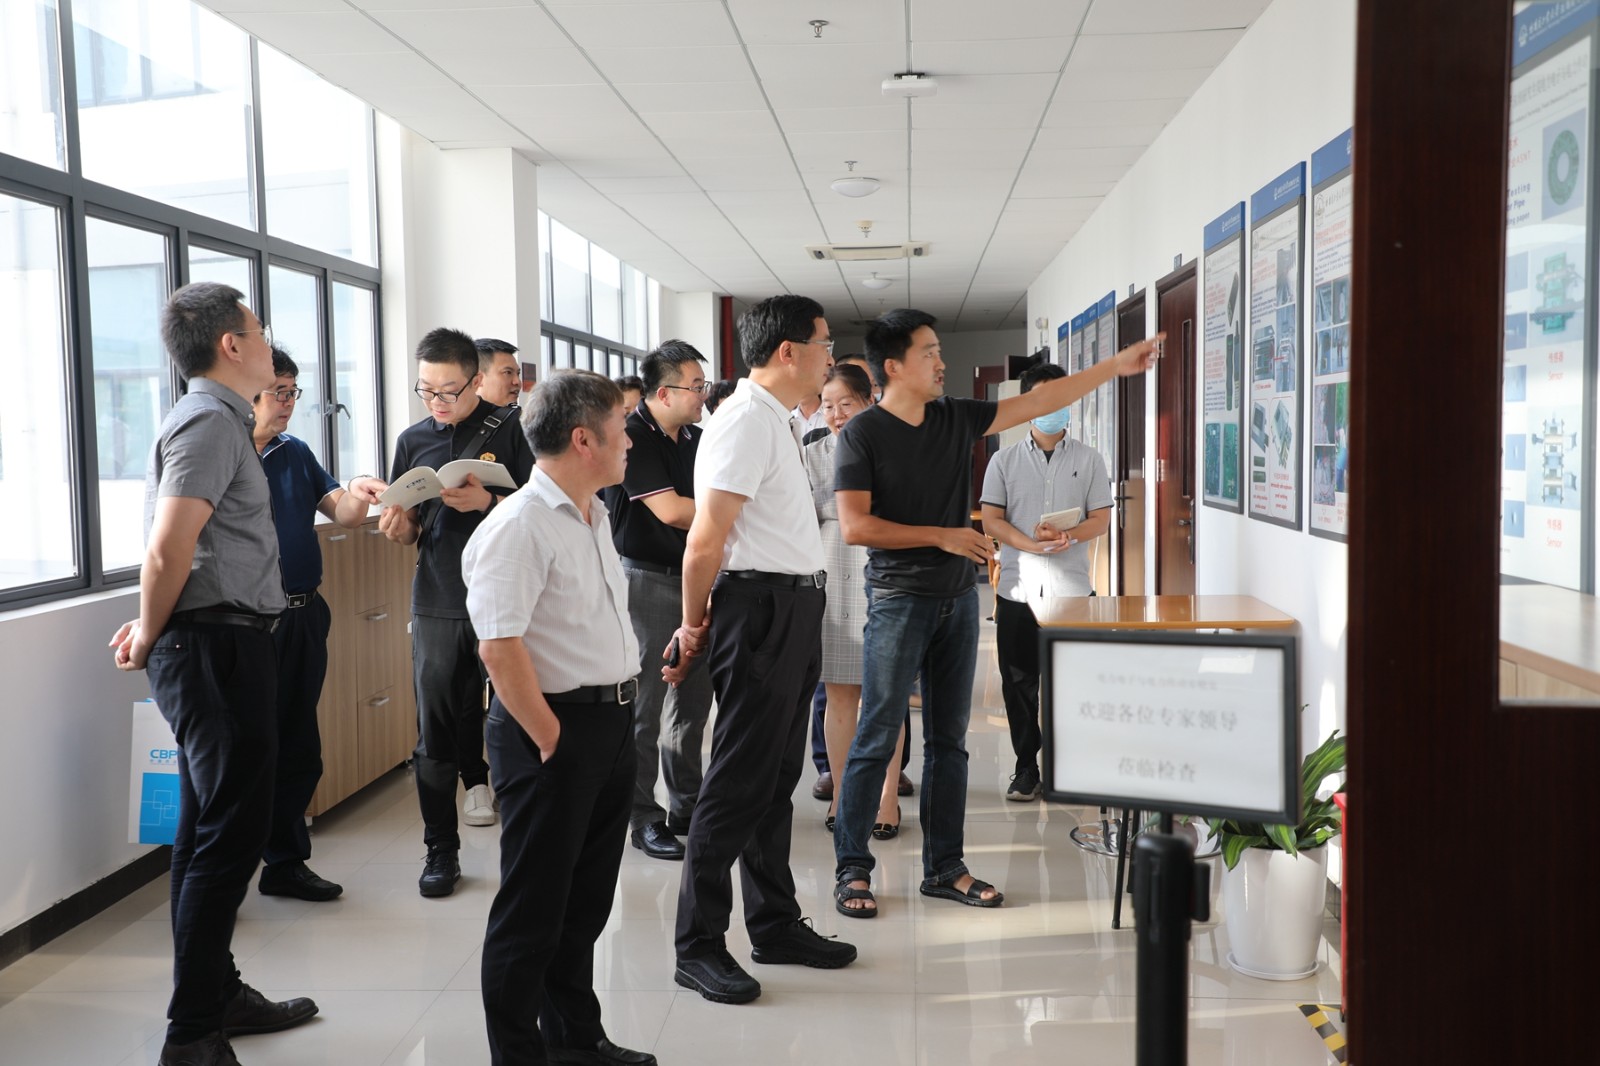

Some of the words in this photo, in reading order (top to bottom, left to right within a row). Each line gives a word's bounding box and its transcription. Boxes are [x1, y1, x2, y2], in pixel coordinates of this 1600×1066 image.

[1079, 700, 1239, 732] 欢迎各位专家领导
